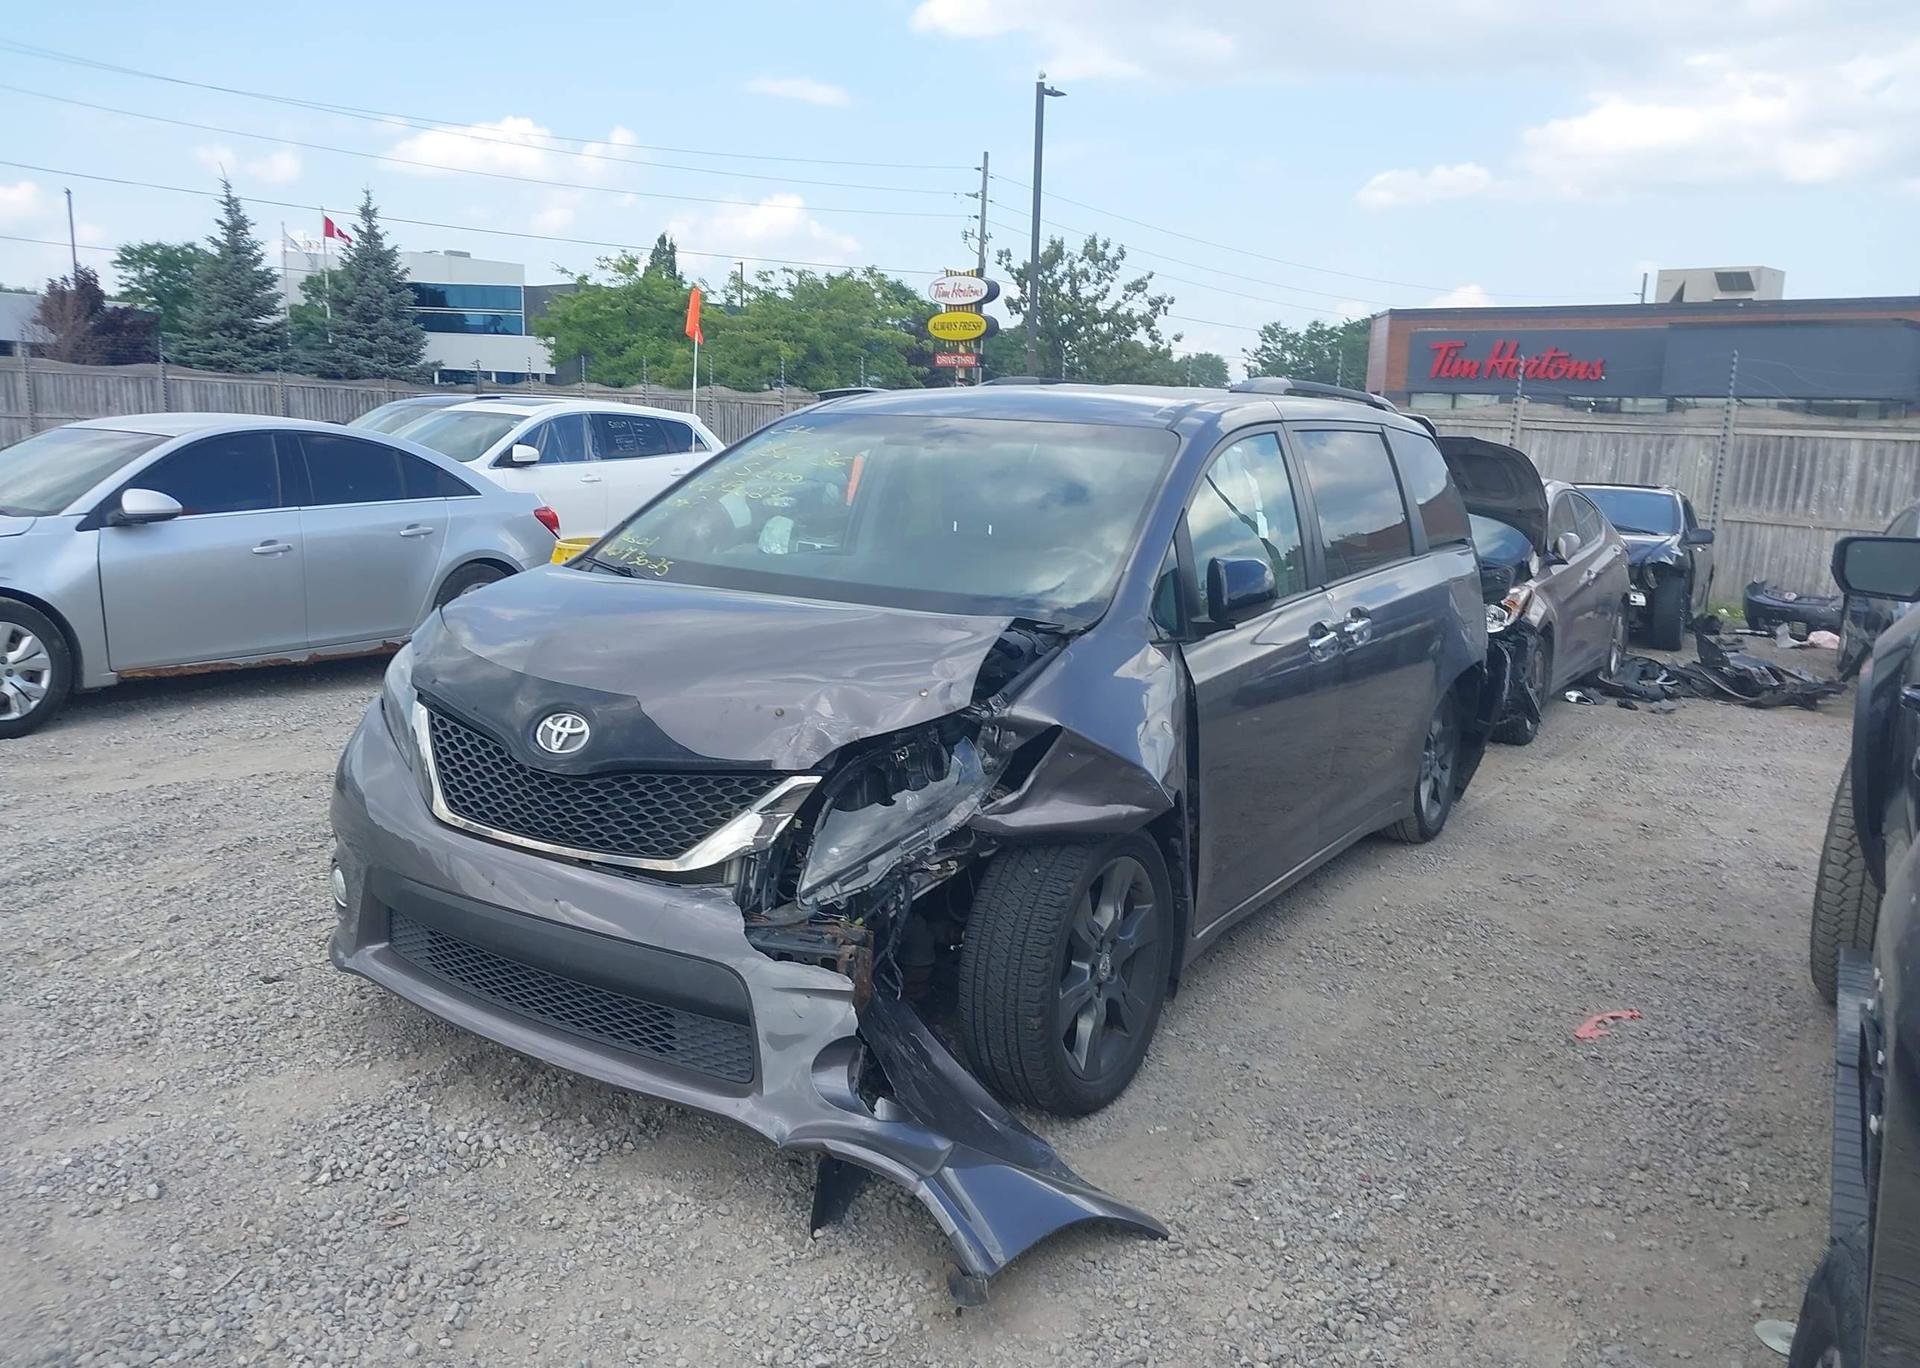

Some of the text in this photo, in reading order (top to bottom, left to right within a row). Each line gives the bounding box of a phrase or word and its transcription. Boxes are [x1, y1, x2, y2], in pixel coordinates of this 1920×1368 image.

[934, 282, 983, 299] Tim Hortons
[934, 321, 982, 331] ALWAYS FRESH
[1430, 339, 1603, 381] Tim Hortons
